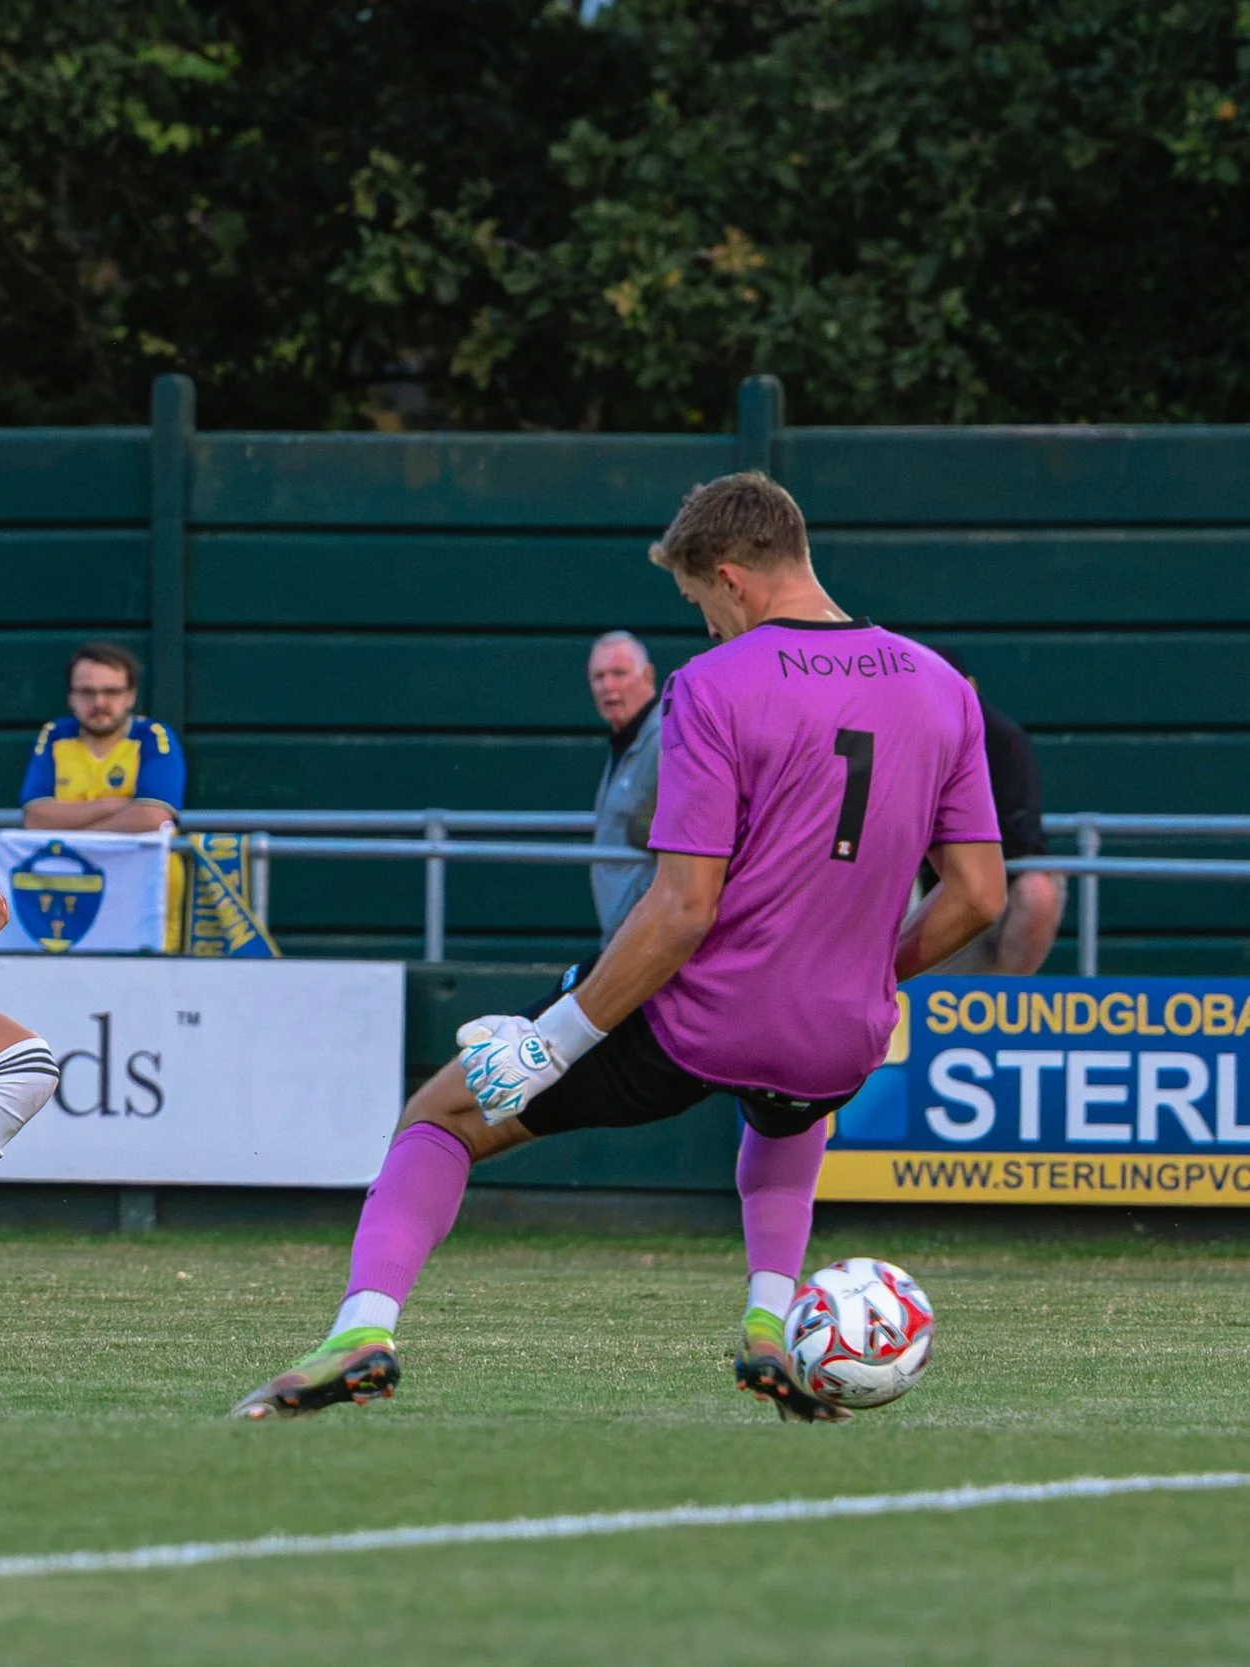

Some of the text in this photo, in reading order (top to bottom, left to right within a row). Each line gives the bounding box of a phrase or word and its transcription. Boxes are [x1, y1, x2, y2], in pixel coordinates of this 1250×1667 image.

[777, 646, 917, 679] Novelis
[830, 728, 875, 863] 1
[924, 1047, 1250, 1144] STERL
